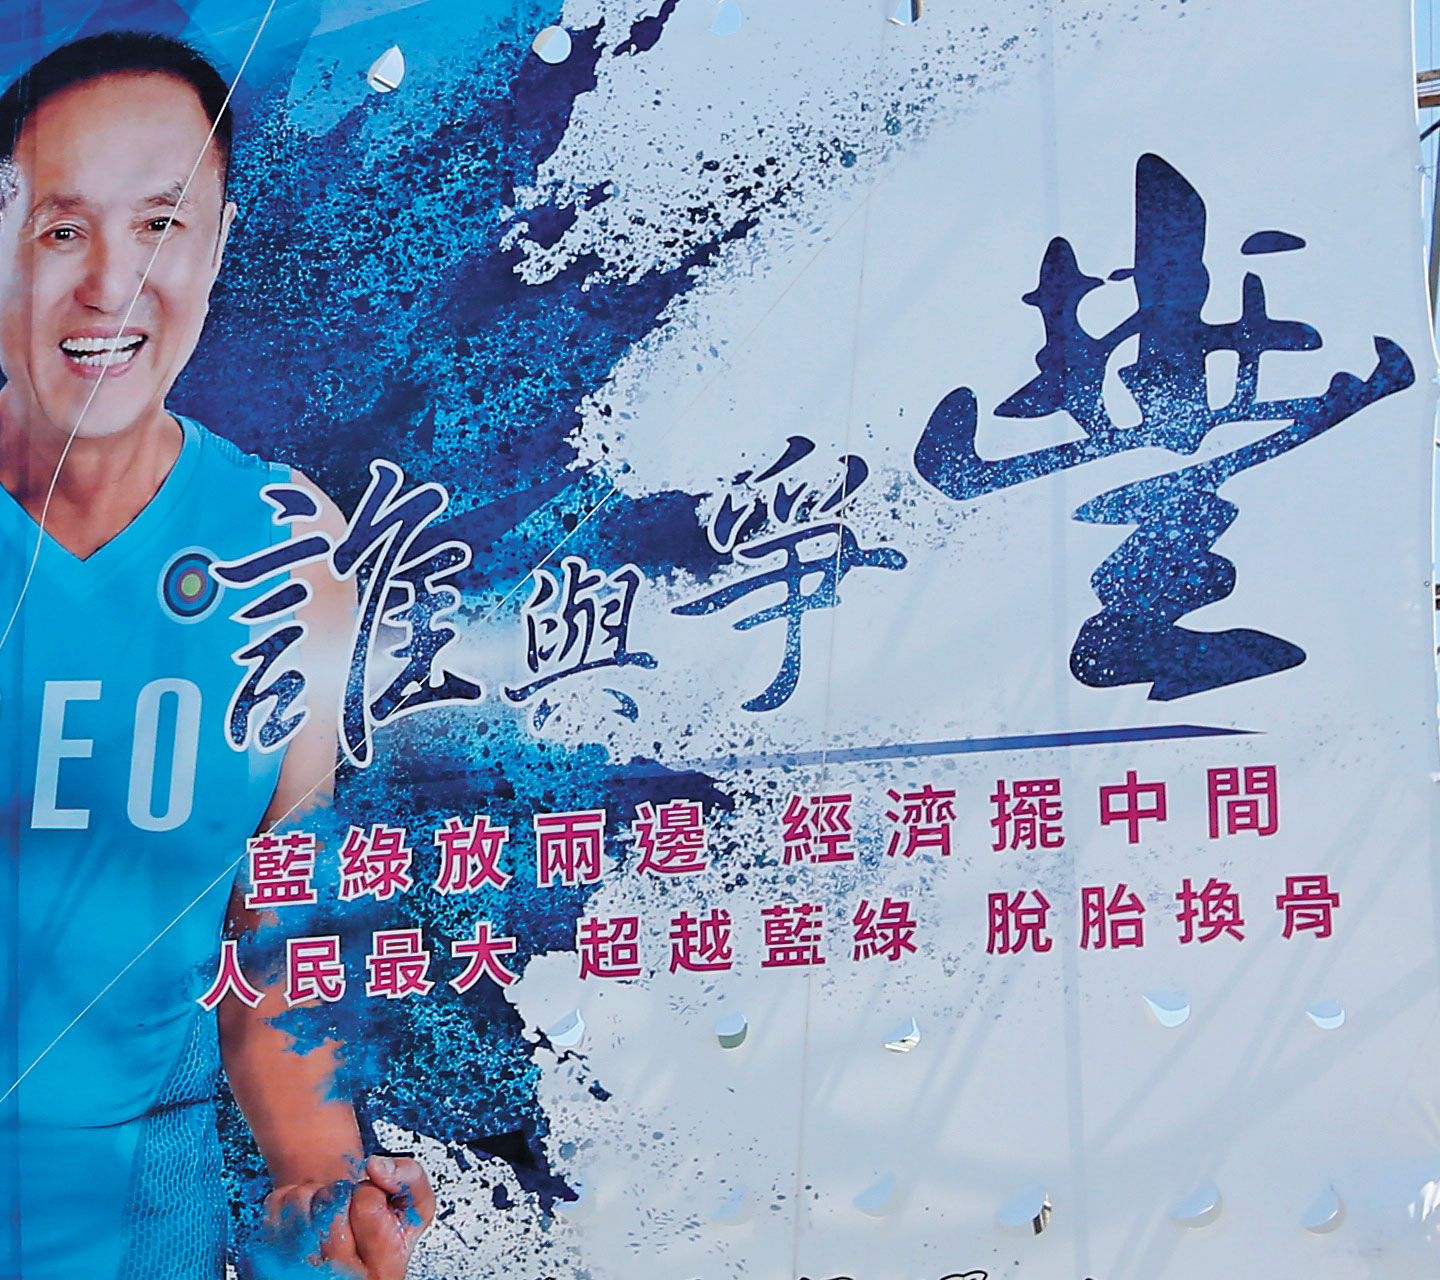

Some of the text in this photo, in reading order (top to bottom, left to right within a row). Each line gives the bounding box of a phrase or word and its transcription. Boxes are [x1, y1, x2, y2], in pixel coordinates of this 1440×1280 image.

[245, 764, 1280, 909] 藍綠放兩邊 經濟擺中間
[198, 872, 1342, 1011] 人民最大 超越藍綠 脫胎換骨
